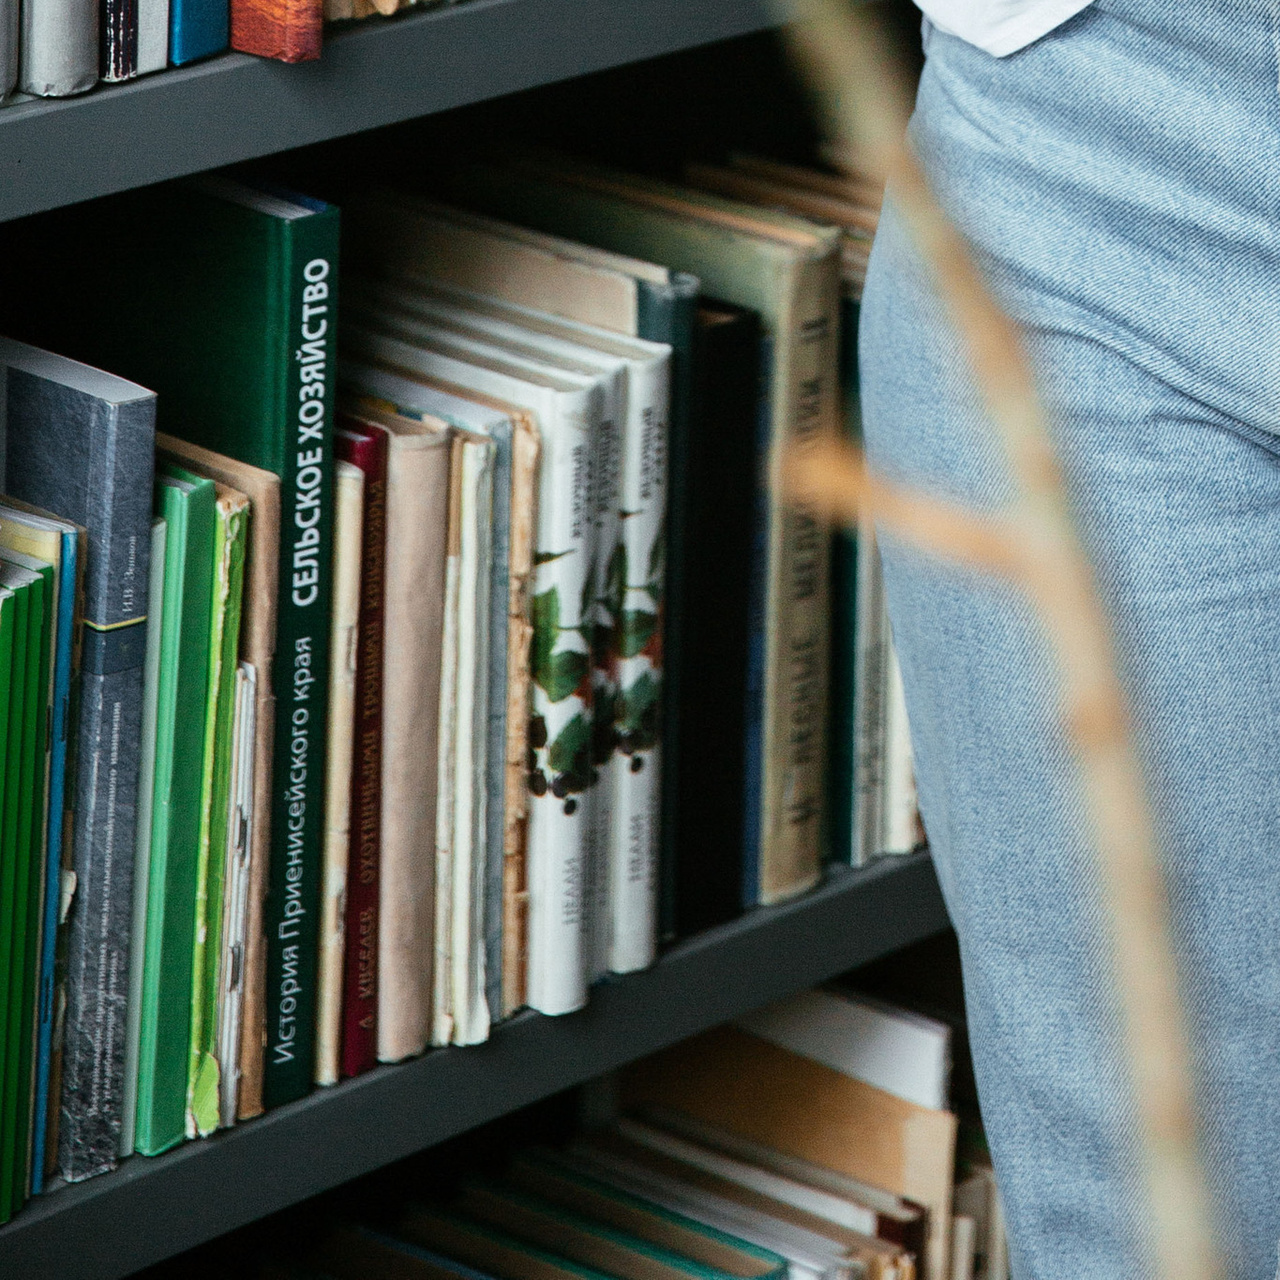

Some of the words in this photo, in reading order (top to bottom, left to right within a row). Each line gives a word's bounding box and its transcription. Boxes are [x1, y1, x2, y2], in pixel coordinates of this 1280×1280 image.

[294, 259, 330, 441] ХОЗЯЙСТВО
[291, 447, 322, 608] СЕЛЬСКОЕ
[108, 701, 122, 766] назначения
[294, 636, 317, 702] края
[279, 708, 312, 940] Приенисейского
[273, 945, 303, 1066] История
